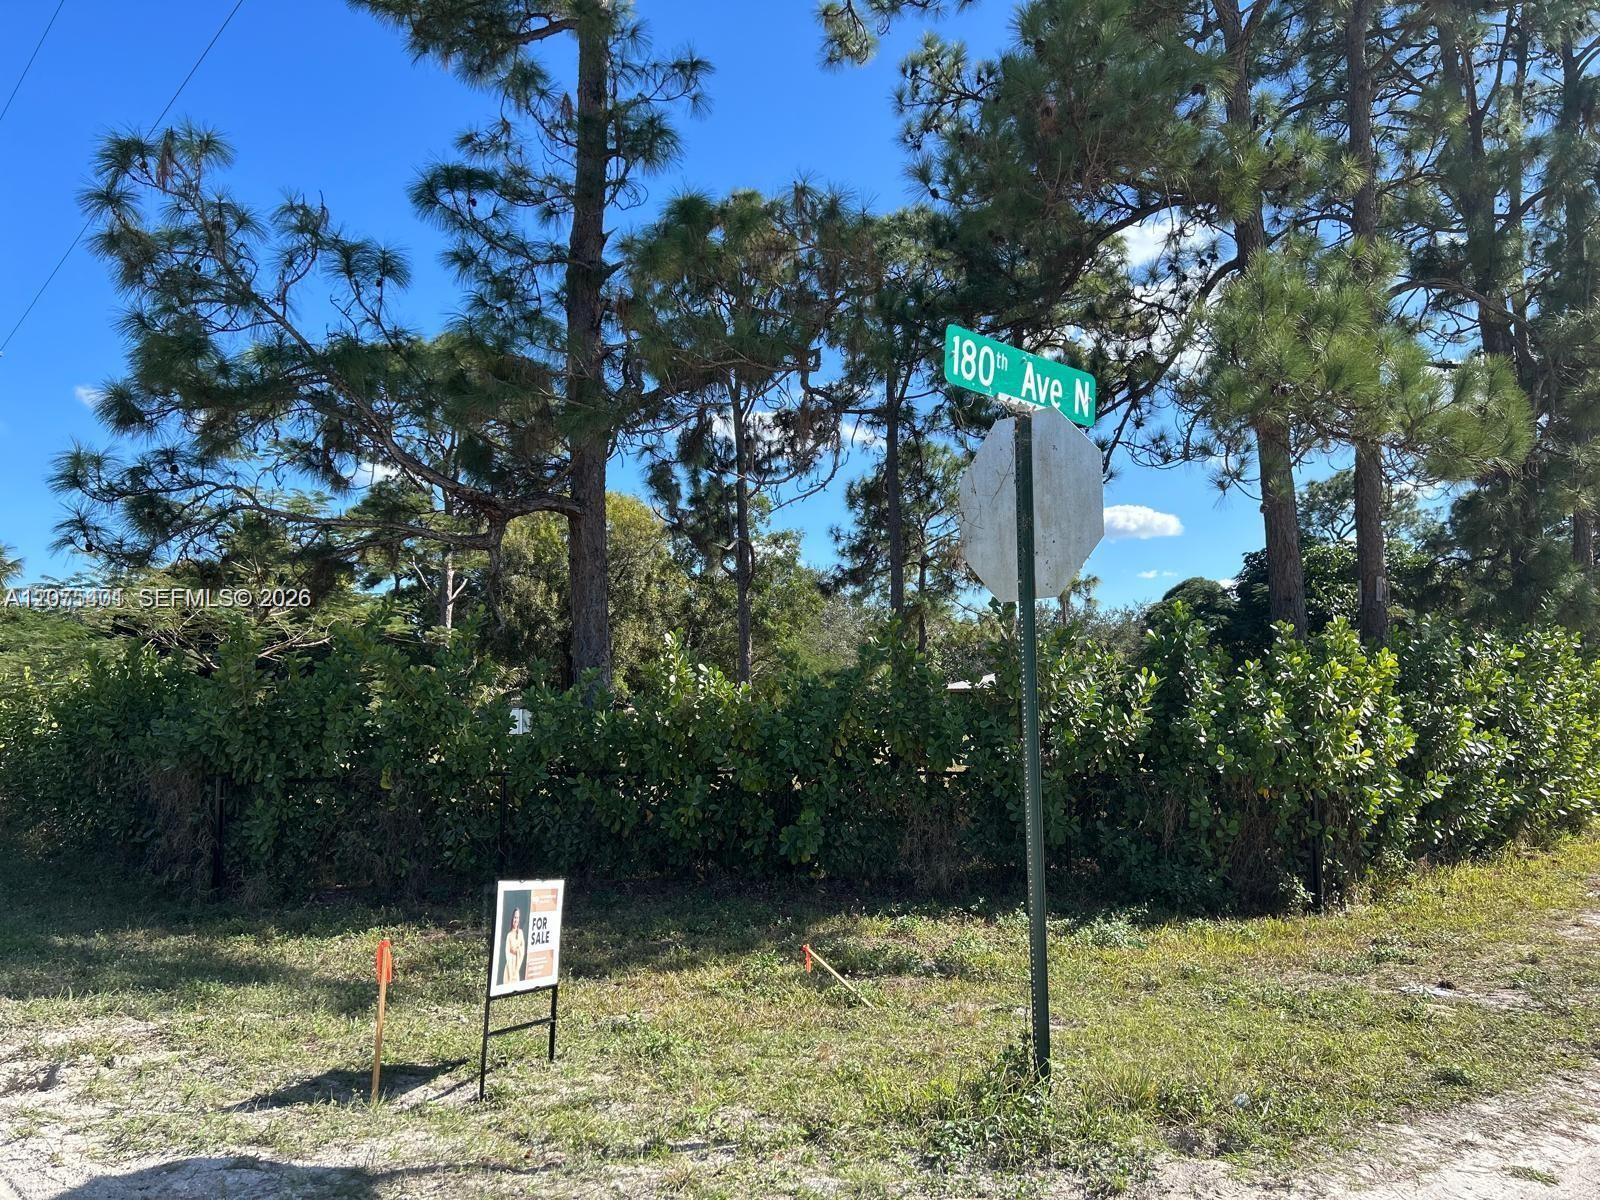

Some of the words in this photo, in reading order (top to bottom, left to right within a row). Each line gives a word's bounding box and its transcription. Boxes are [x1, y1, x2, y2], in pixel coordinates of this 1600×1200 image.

[952, 335, 1009, 387] 180th
[1020, 361, 1063, 409] Ave
[1074, 378, 1090, 418] N
[531, 916, 548, 931] FOR
[530, 930, 550, 946] SALE
